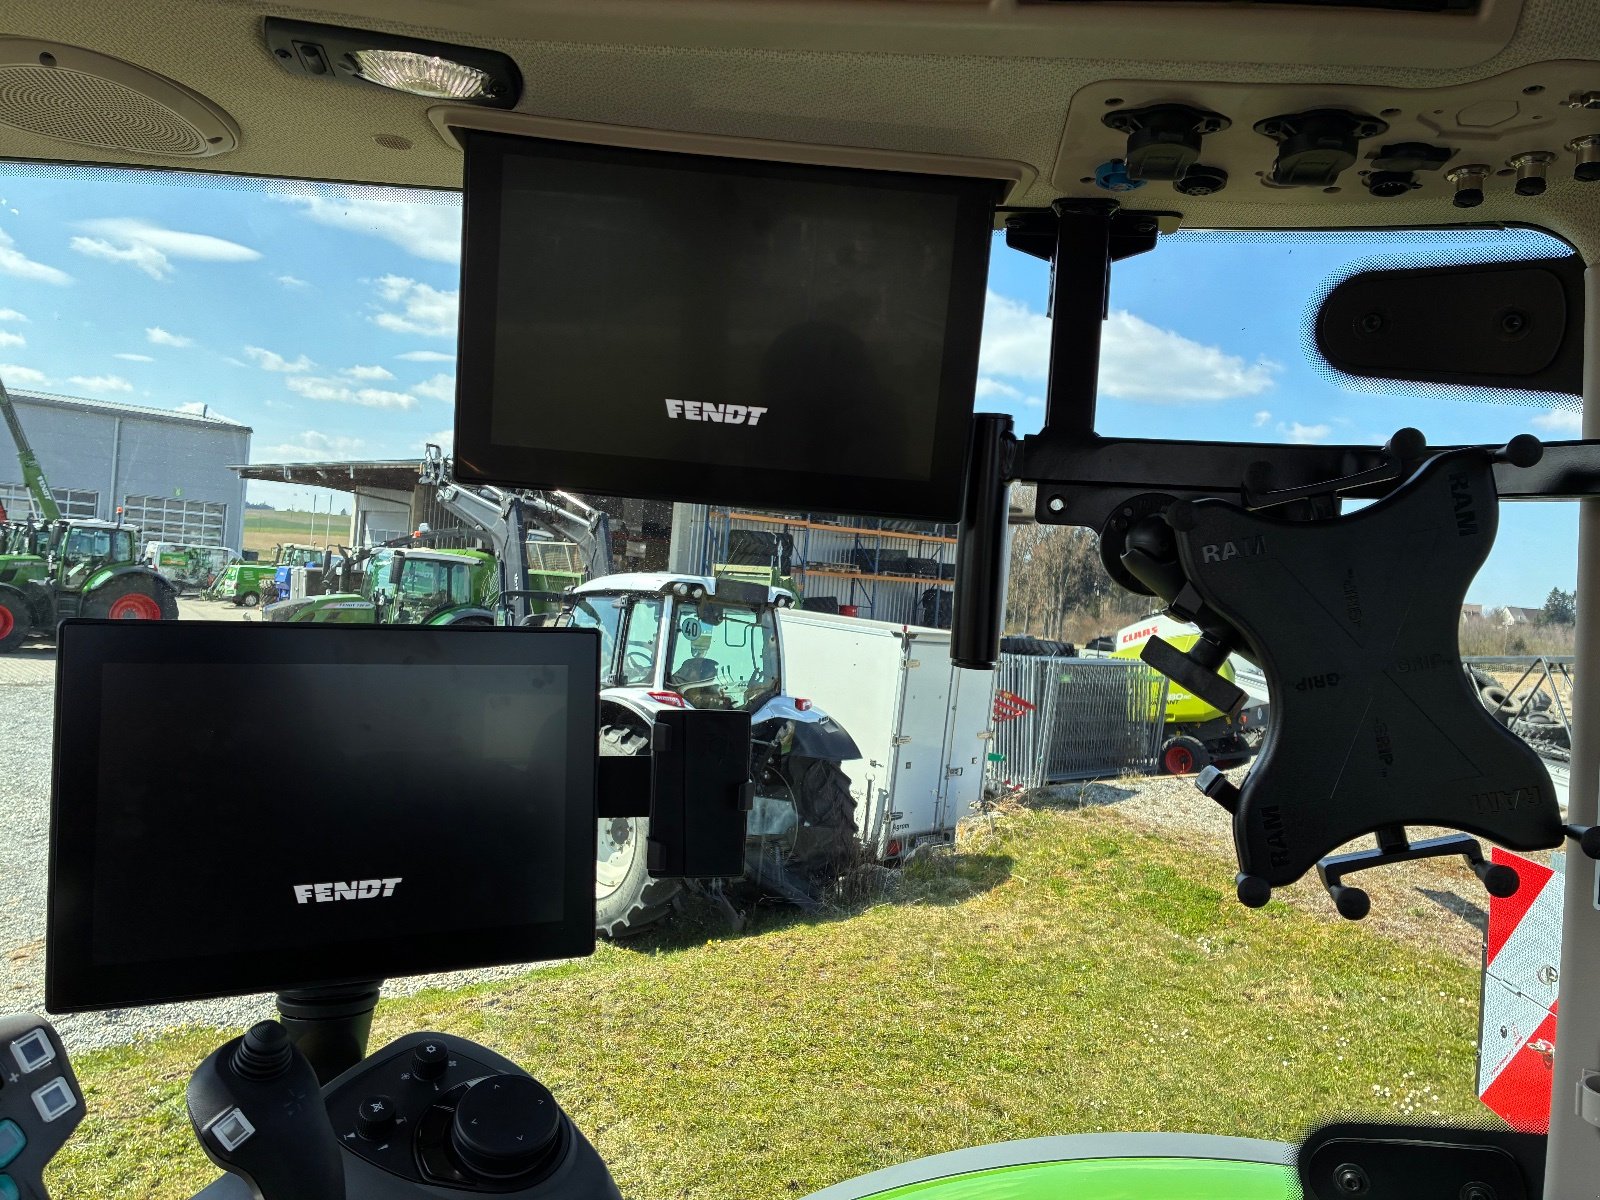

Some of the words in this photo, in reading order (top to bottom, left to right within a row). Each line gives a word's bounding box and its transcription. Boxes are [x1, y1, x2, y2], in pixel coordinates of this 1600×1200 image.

[665, 398, 768, 426] FENDT
[1448, 474, 1480, 537] RAM
[685, 621, 698, 637] 40
[1122, 626, 1159, 644] CLAAS
[293, 877, 403, 904] FENDT
